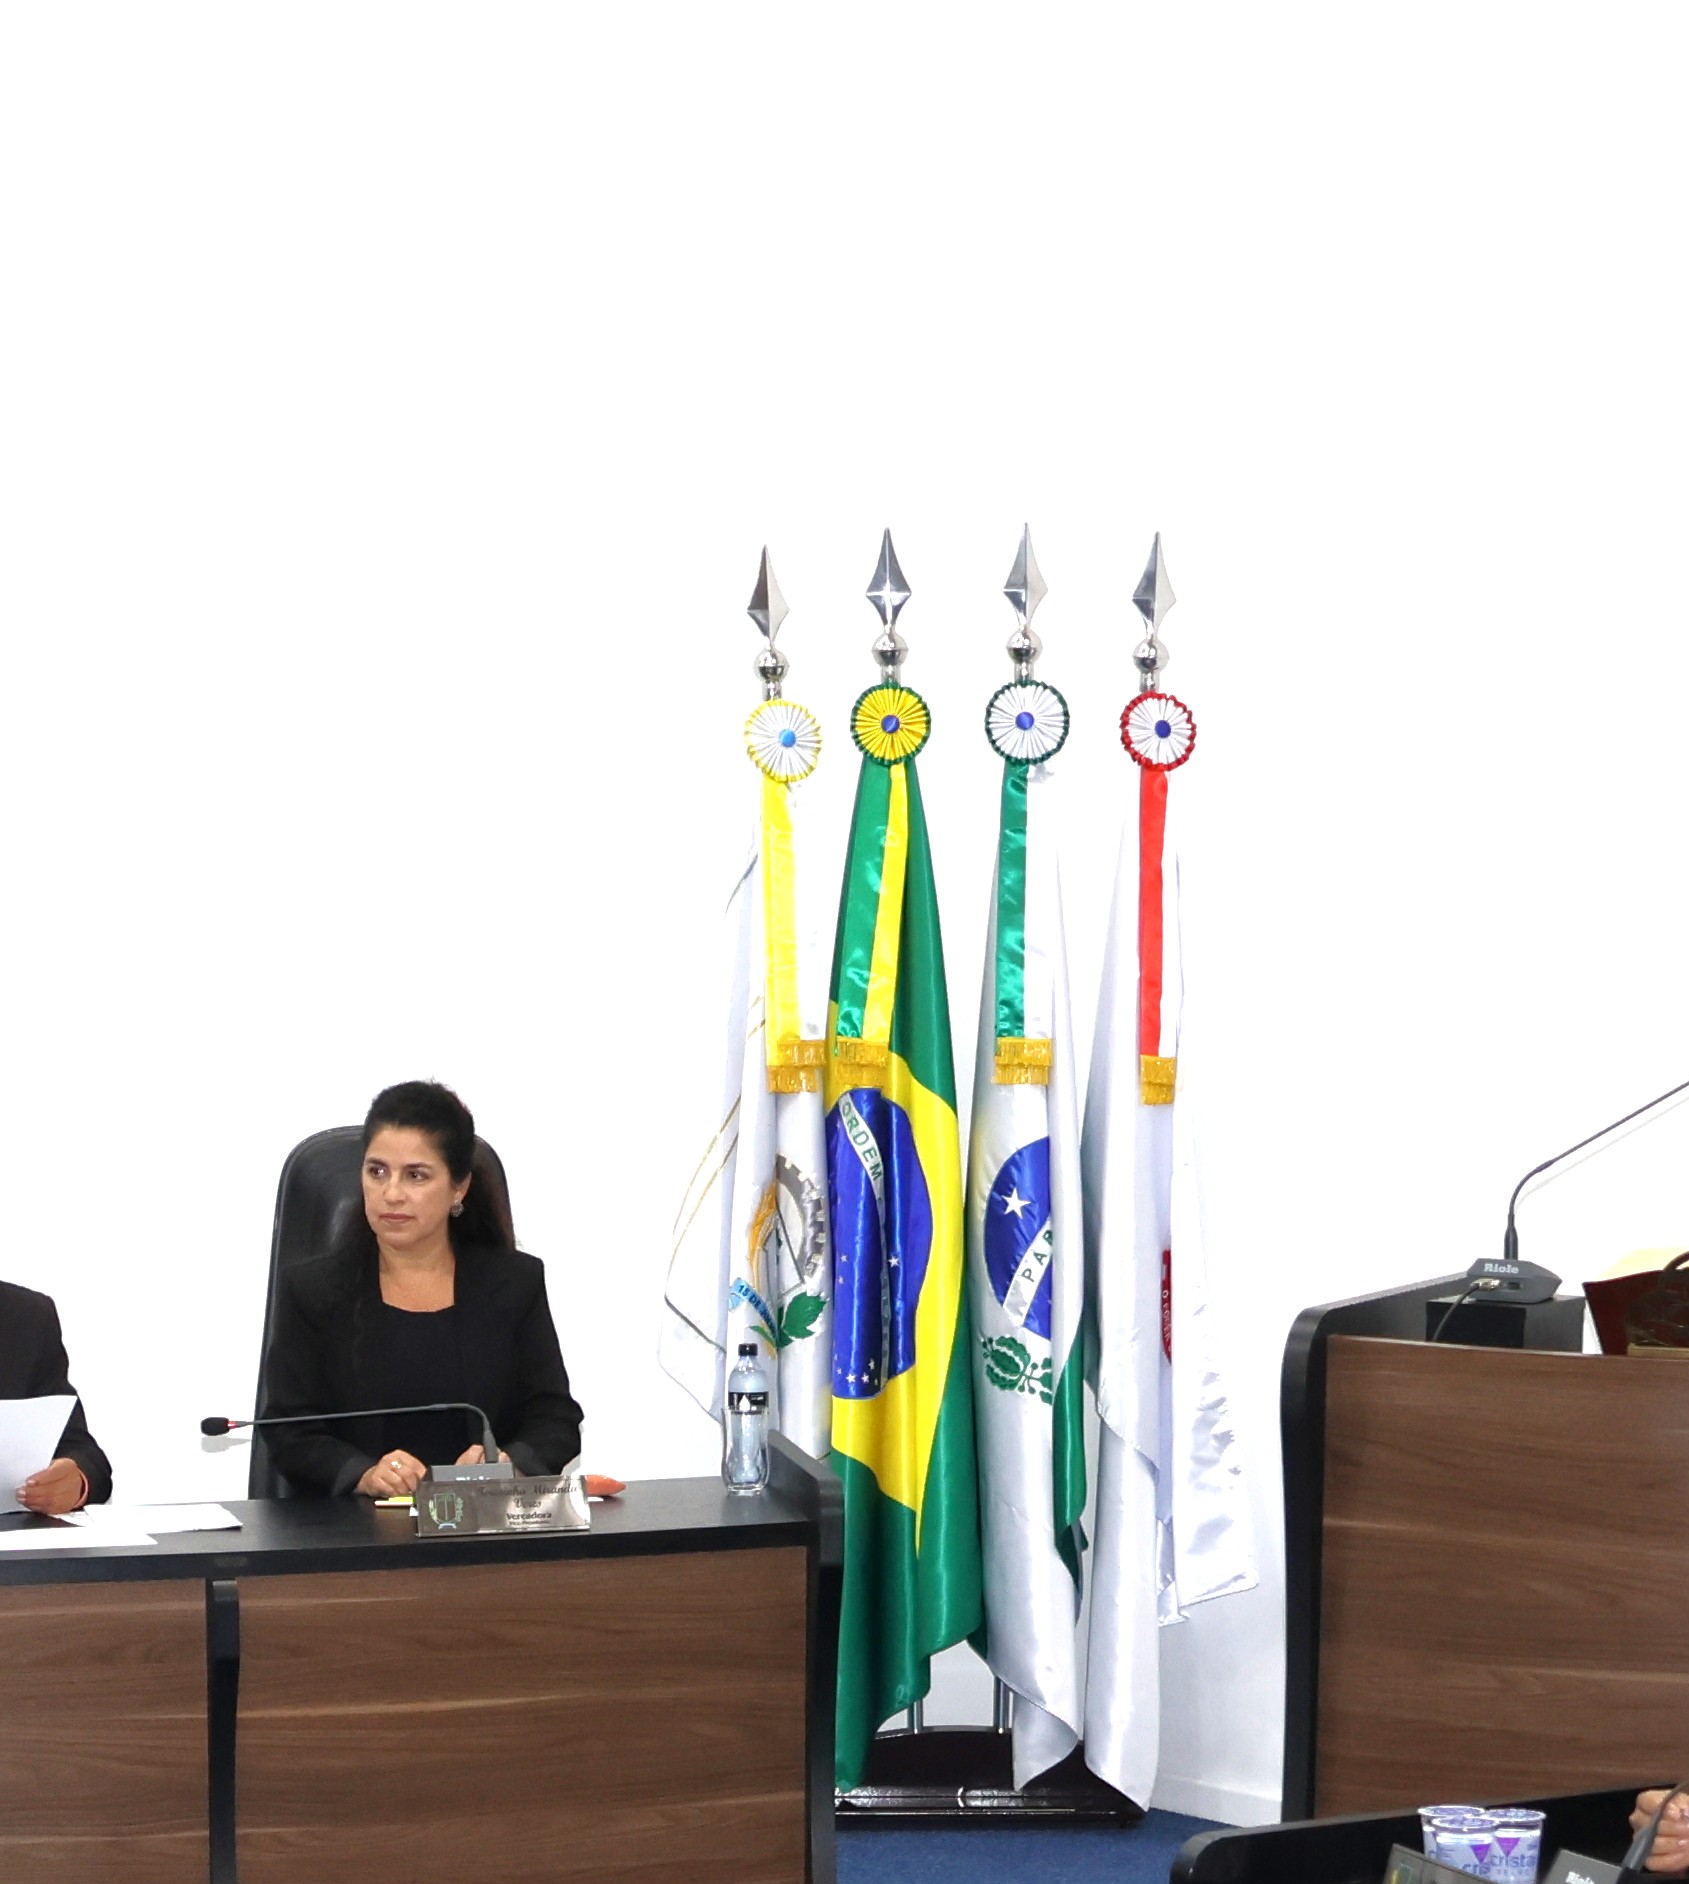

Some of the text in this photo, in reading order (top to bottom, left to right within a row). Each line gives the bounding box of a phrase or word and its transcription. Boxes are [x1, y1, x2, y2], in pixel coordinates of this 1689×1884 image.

[842, 1101, 883, 1181] ORDEM
[1019, 1229, 1053, 1283] PAR
[738, 1284, 751, 1297] 15
